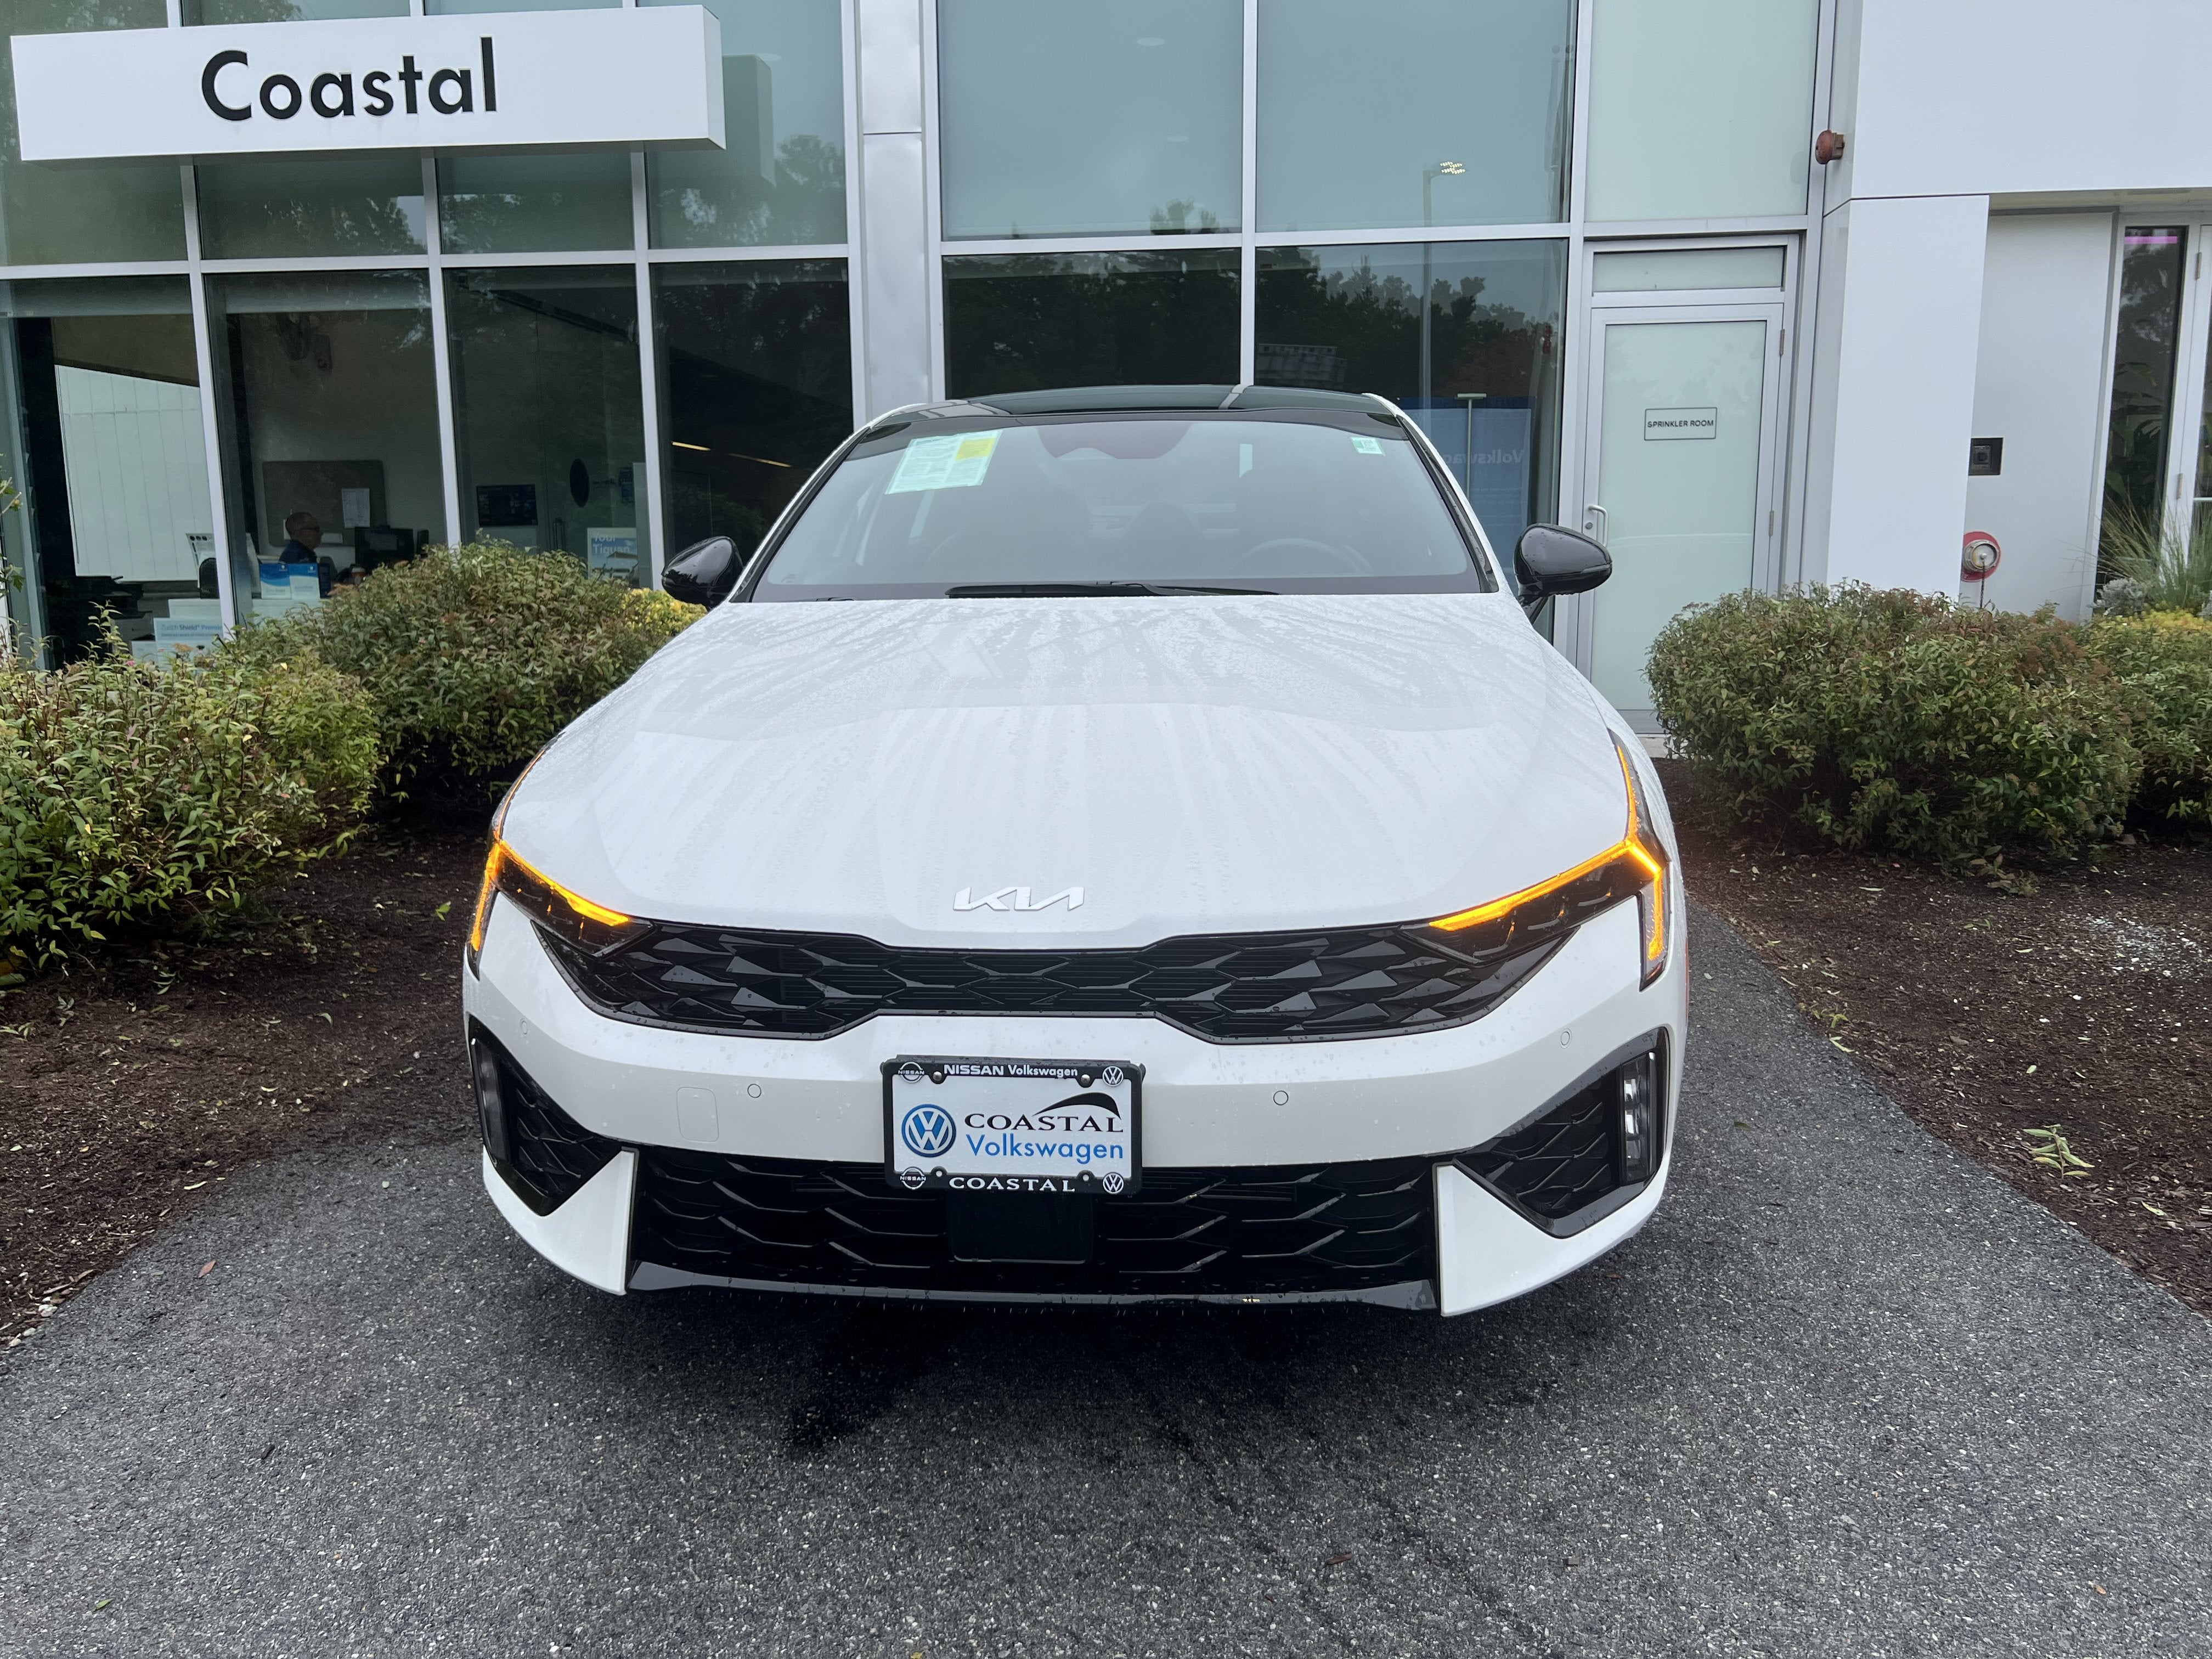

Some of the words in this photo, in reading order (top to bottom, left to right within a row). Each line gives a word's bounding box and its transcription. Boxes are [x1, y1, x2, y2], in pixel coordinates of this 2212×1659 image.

[201, 36, 496, 121] Coastal
[953, 887, 1084, 911] KIA
[944, 1064, 1003, 1076] NISSAN
[1007, 1064, 1078, 1079] Volkswagen
[964, 1113, 1124, 1133] COASTAL
[966, 1133, 1124, 1164] Volkswagen
[949, 1177, 1075, 1192] COASTAL
